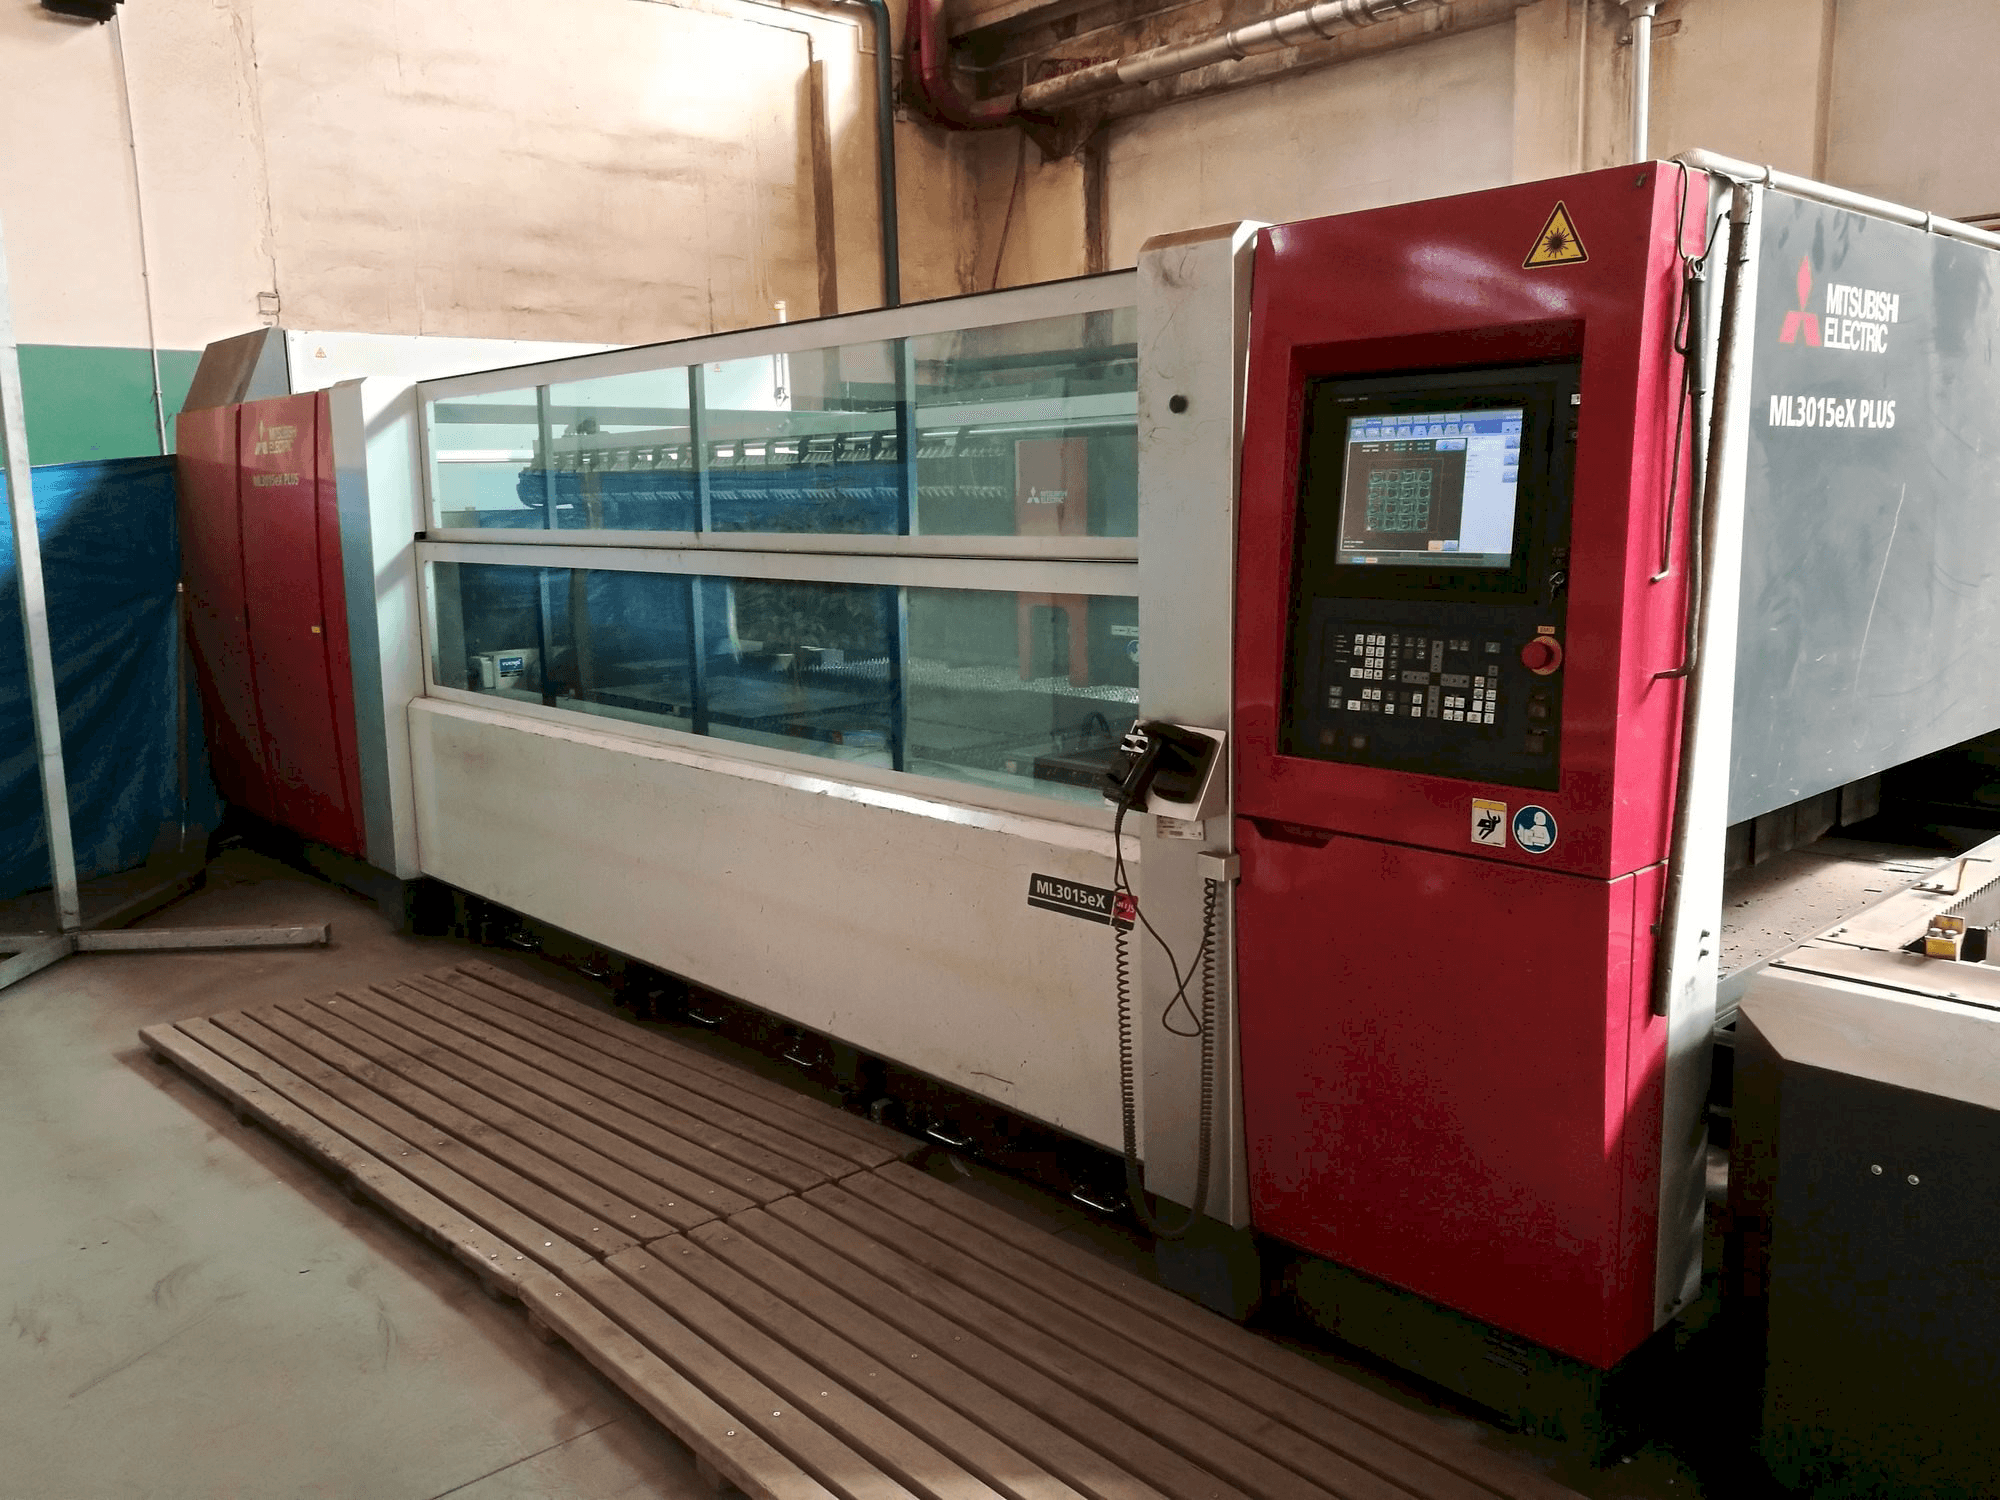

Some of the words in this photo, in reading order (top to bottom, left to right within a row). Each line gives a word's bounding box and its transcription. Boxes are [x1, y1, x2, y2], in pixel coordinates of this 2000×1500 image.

[1826, 283, 1899, 323] MITSUBISHI
[1824, 317, 1888, 353] ELECTRIC
[1769, 395, 1857, 428] ML3015eX
[1859, 399, 1896, 429] PLUS
[1036, 880, 1105, 909] ML3015eX
